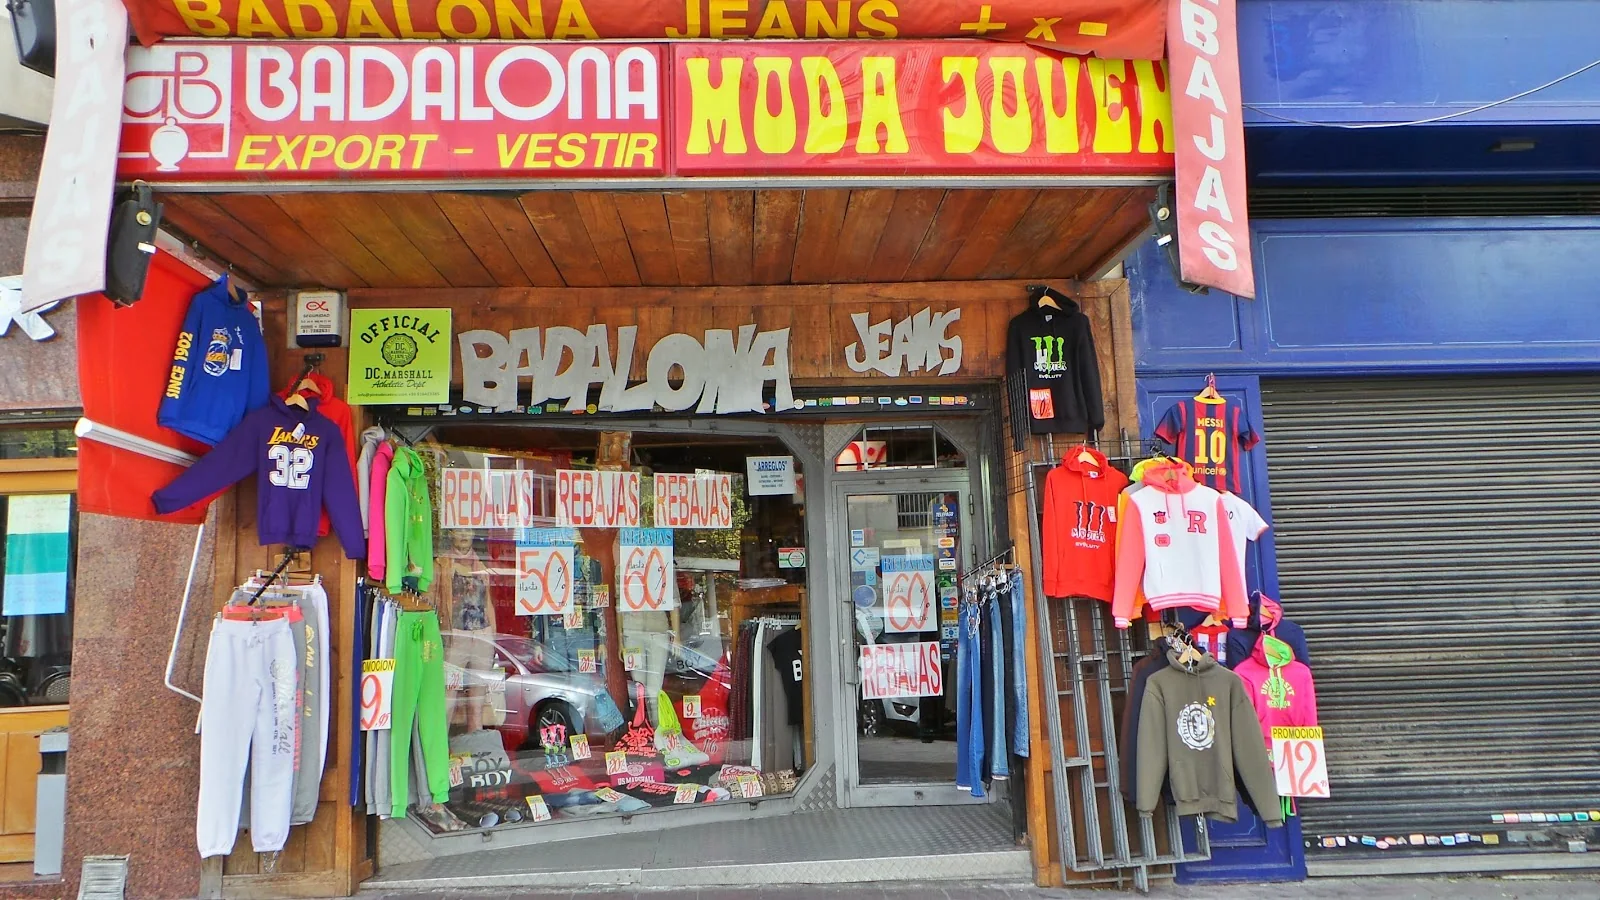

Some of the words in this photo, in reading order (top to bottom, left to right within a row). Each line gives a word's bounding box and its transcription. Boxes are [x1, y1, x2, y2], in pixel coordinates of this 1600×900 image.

[178, 0, 600, 39] BADALONA
[666, 0, 899, 39] JEANS
[246, 46, 658, 122] BADALONA
[686, 56, 909, 154] MODA
[235, 134, 437, 172] EXPORT
[495, 132, 658, 169] VESTIR
[1179, 0, 1239, 272] BAJAS
[173, 331, 194, 362] 1902
[360, 315, 441, 345] OFFICIAL
[457, 323, 792, 415] BADALONA
[844, 305, 963, 377] JEANS
[166, 365, 186, 399] SINCE
[1197, 417, 1224, 428] MESSI
[1194, 428, 1227, 465] 10
[268, 444, 314, 490] 32
[444, 470, 533, 527] REBAJAS
[558, 471, 639, 527] REBAJAS
[656, 474, 730, 527] REBAJAS
[1187, 510, 1207, 534] R
[362, 660, 394, 673] OMOCION
[863, 642, 941, 698] REBAJAS
[1272, 727, 1321, 740] PROMOCION
